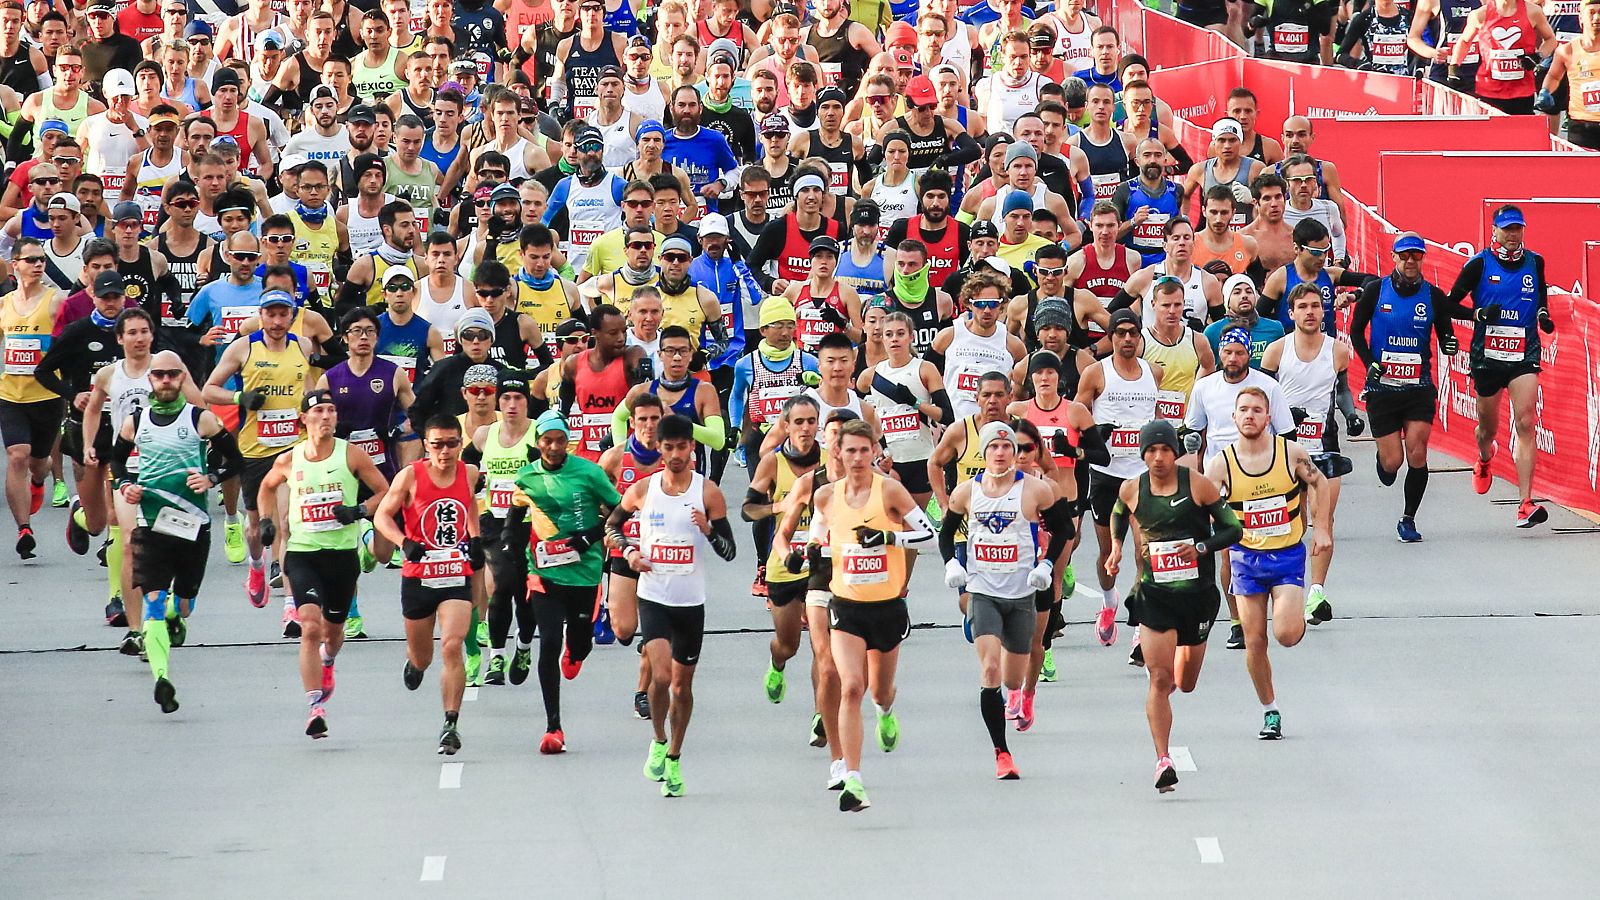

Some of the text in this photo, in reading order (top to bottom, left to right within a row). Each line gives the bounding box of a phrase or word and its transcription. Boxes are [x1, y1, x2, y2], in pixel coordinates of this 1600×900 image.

[411, 20, 417, 30] A
[1279, 33, 1303, 43] A 4041
[1375, 45, 1404, 54] A 15083
[356, 81, 394, 92] MÉXICO
[1587, 93, 1593, 103] A
[576, 107, 581, 117] A
[1191, 104, 1209, 117] AMERICA
[308, 152, 340, 160] HOKA
[765, 197, 796, 208] UNNIN
[148, 213, 154, 223] A
[1138, 226, 1144, 235] A
[572, 232, 579, 243] A
[1087, 277, 1106, 289] EAST
[1501, 309, 1519, 321] DAZA
[225, 320, 231, 331] A
[806, 321, 835, 333] A 4099
[1388, 335, 1418, 348] CLAUDIO
[1491, 339, 1520, 350] A 2167
[8, 351, 35, 362] A 7091
[1385, 365, 1416, 377] A 2181
[962, 377, 969, 389] A
[264, 384, 294, 396] CHILE
[586, 394, 615, 408] AON
[766, 402, 772, 412] A
[264, 421, 295, 435] A 1056
[882, 416, 918, 432] A 13164
[589, 428, 596, 438] A
[1114, 433, 1122, 444] A
[487, 460, 527, 470] CHICAGO
[319, 482, 343, 493] THE
[1255, 483, 1269, 491] EAST
[492, 492, 499, 505] A
[303, 508, 310, 520] A
[1251, 510, 1283, 526] A 7077
[435, 502, 458, 547] 任性
[630, 522, 638, 535] A
[652, 547, 692, 561] A 19179
[977, 550, 1015, 562] A 13197
[847, 555, 883, 570] A 5060
[1157, 555, 1192, 571] A 21
[423, 563, 463, 577] A 19196
